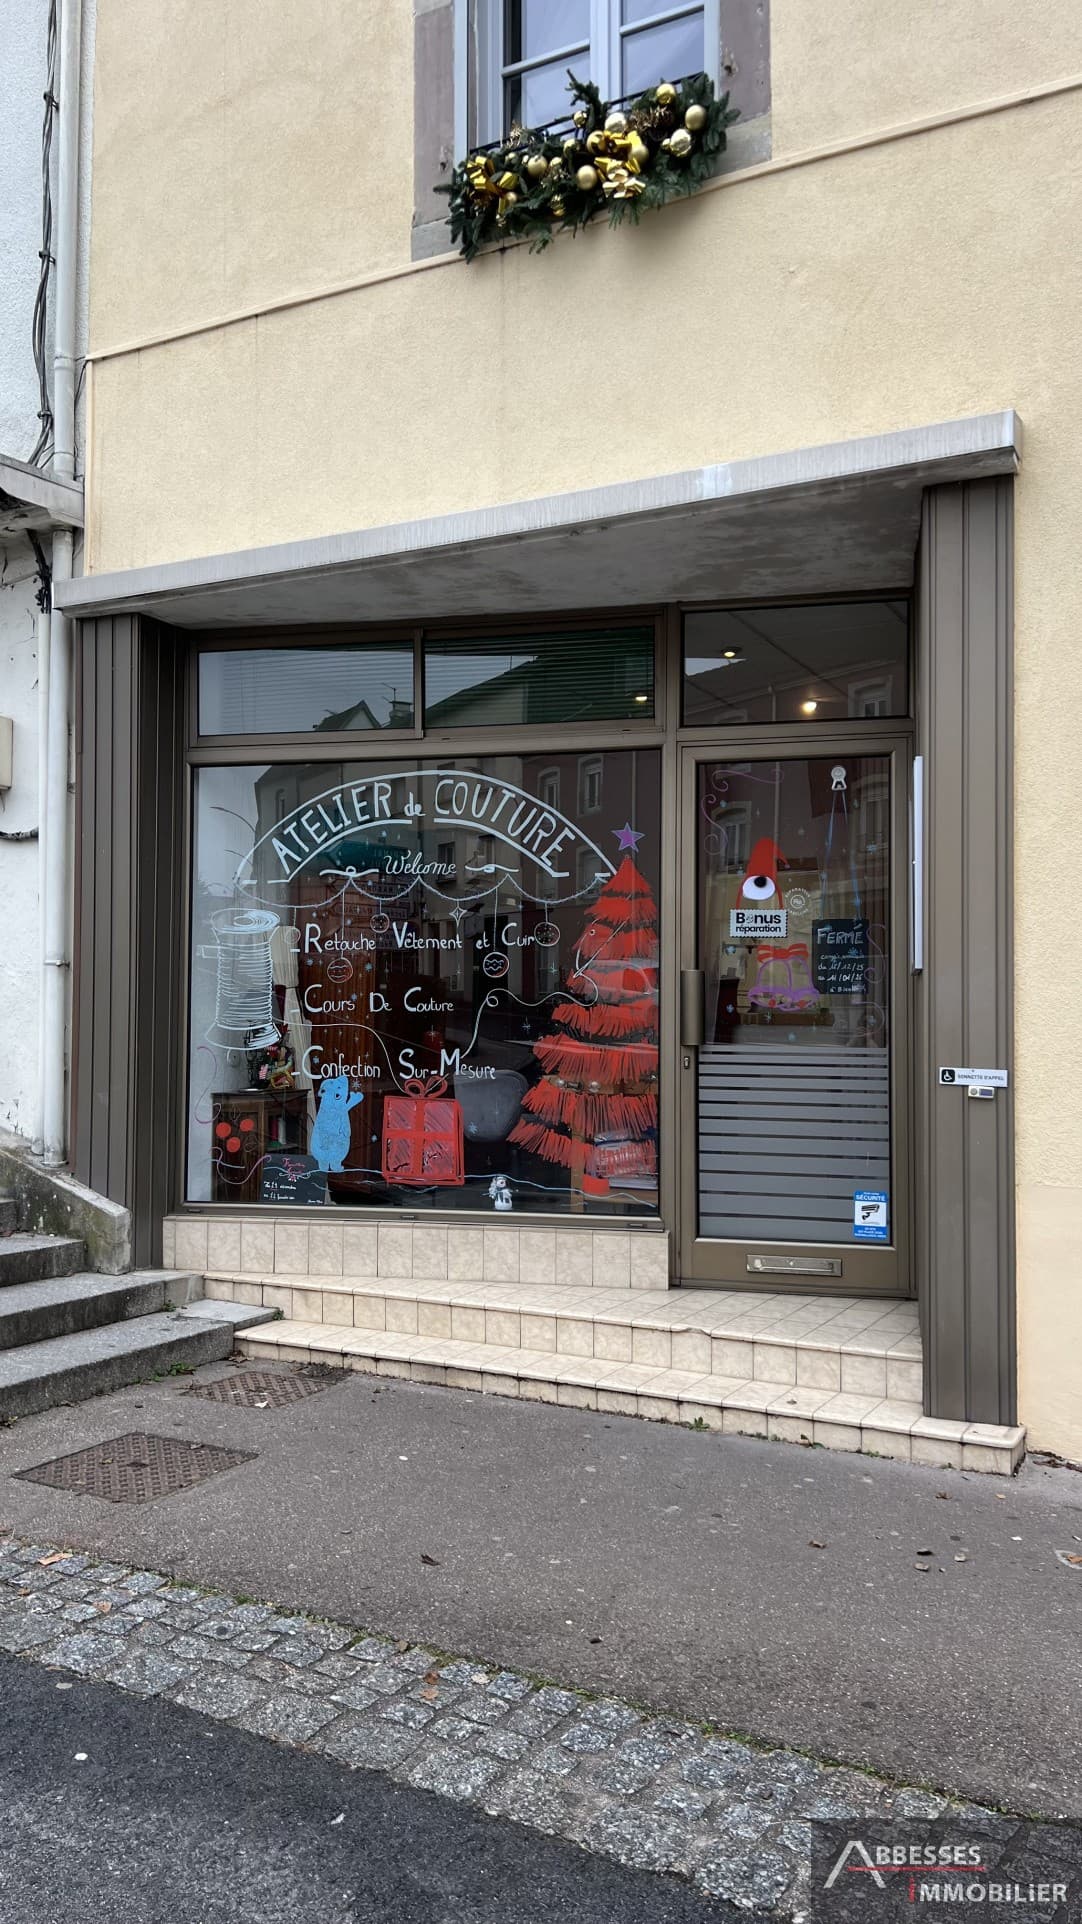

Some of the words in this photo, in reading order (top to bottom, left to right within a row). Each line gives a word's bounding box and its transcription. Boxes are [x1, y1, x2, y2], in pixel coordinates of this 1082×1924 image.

[271, 781, 393, 874] ATELIER
[403, 791, 426, 817] de
[434, 778, 577, 868] COUTURE
[383, 849, 458, 876] Welcome
[392, 921, 463, 950] Vêtement
[475, 934, 491, 949] et
[501, 922, 536, 948] Cuir
[735, 923, 782, 935] réparation
[816, 923, 864, 945] FERMÉ
[368, 991, 393, 1013] De
[403, 986, 455, 1013] Couture
